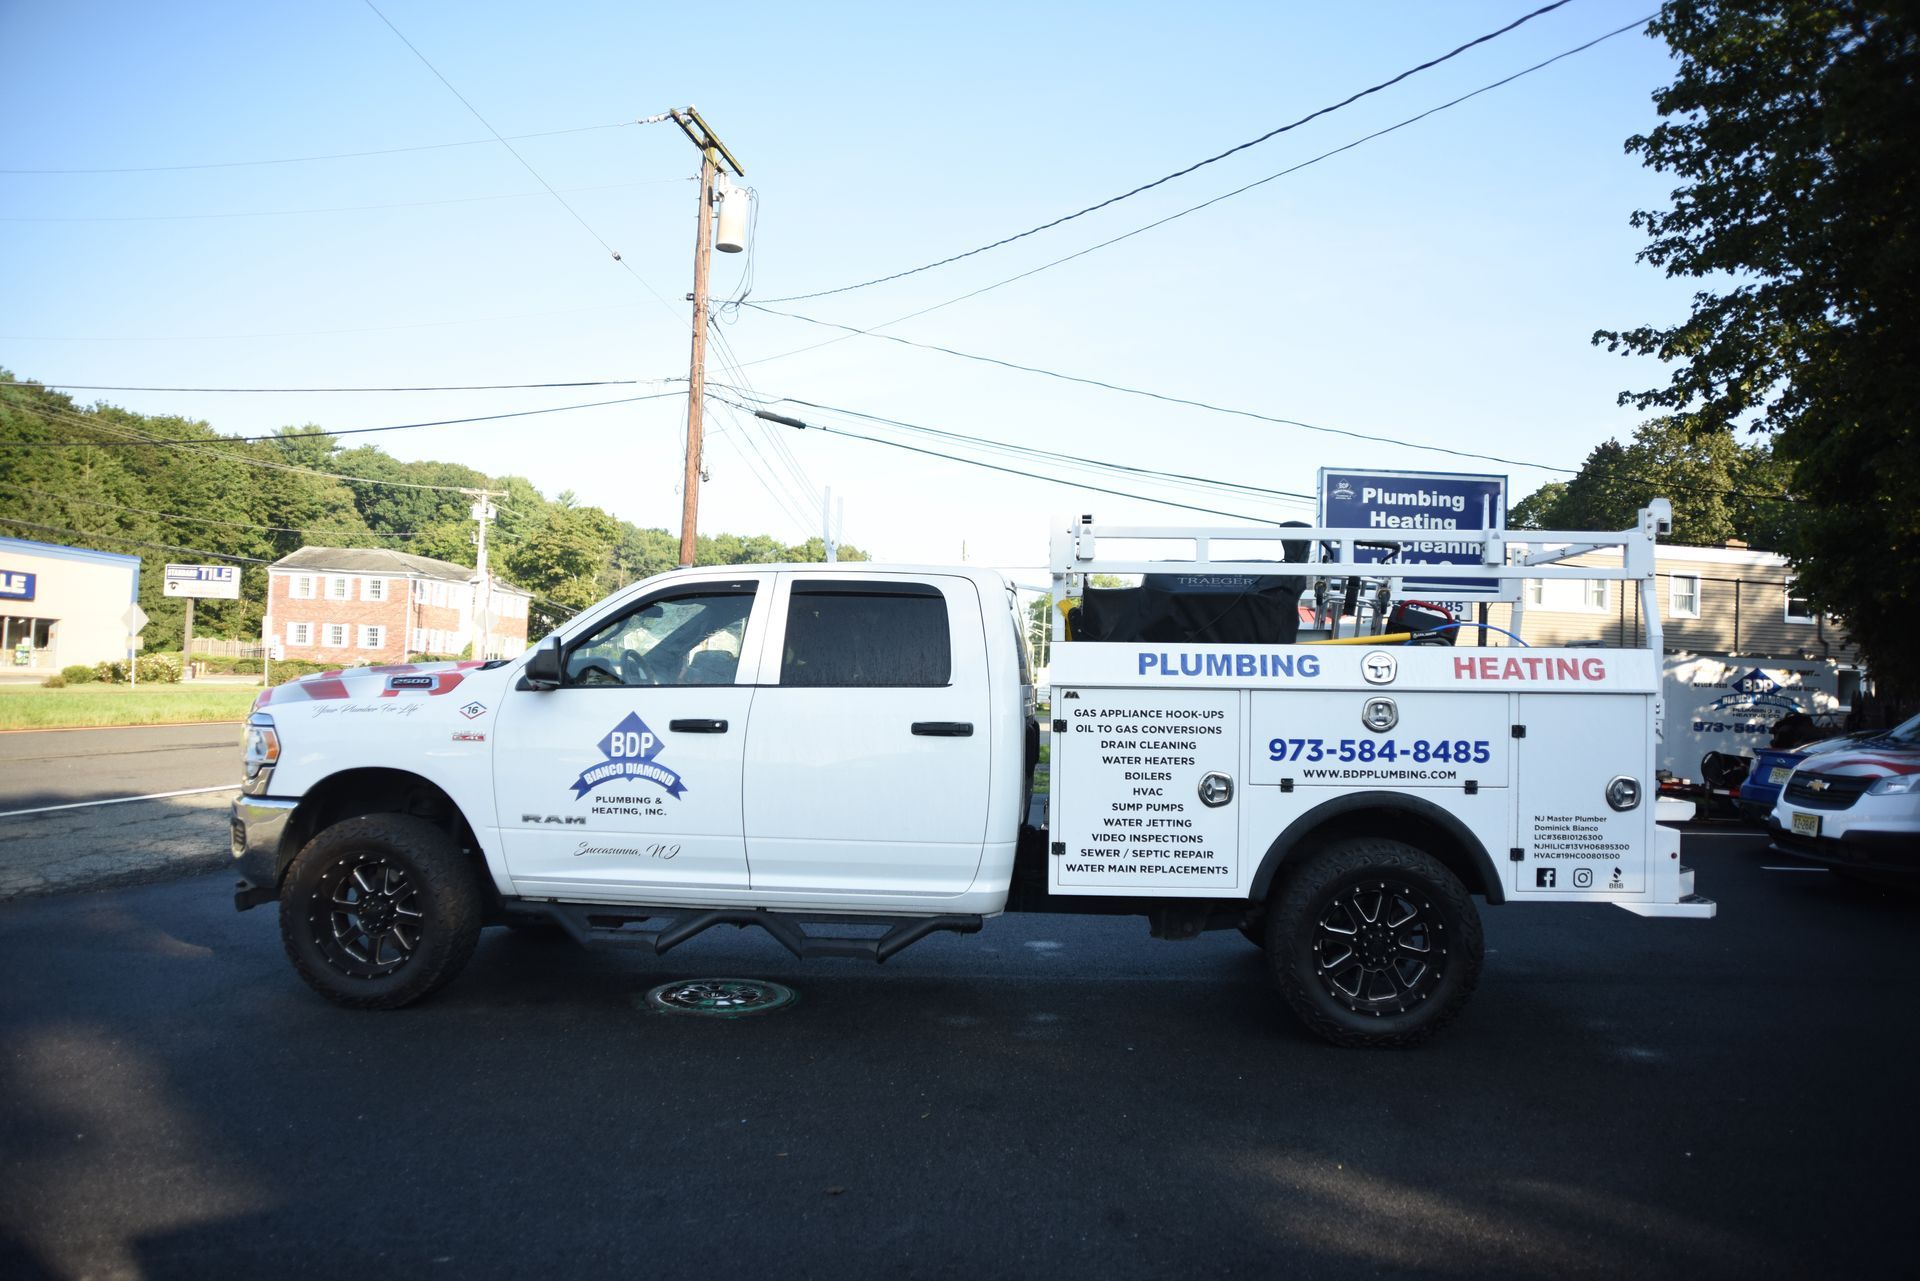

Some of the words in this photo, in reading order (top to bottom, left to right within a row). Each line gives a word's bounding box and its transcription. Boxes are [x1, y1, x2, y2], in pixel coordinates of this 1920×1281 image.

[1362, 487, 1465, 511] Plumbing
[1370, 511, 1456, 530] Heating
[199, 567, 232, 581] TILE
[1177, 577, 1254, 585] TRAEGER
[1138, 652, 1321, 678] PLUMBING
[1454, 656, 1606, 681] HEATING
[1743, 679, 1774, 692] BDP
[1722, 695, 1752, 704] BIANCO
[467, 706, 479, 715] 16
[1074, 709, 1096, 718] GAS
[1100, 710, 1162, 718] APPLIANCE
[1165, 710, 1224, 719] HOOK-UPS
[1076, 725, 1094, 733] OIL
[1097, 725, 1112, 733] TO
[1115, 725, 1138, 733] GAS
[1142, 726, 1222, 735] CONVERSIONS
[610, 732, 654, 758] BDP
[1101, 741, 1136, 749] DRAIN
[1140, 741, 1196, 750] CLEANING
[1269, 738, 1490, 763] 973-584-8485
[1102, 756, 1141, 765] WATER
[1144, 757, 1195, 765] HEATERS
[583, 763, 624, 785] BIANCO
[625, 763, 675, 787] DIAMOND
[1125, 772, 1172, 780] BOILERS
[1303, 770, 1456, 779] WWW.BDPPLUMBING.COM
[1133, 788, 1163, 796] HVAC
[596, 796, 651, 804] PLUMBING
[592, 807, 642, 816] HEATING,
[646, 808, 667, 816] INC.
[1112, 803, 1143, 811] SUMP
[1146, 803, 1184, 812] PUMPS
[522, 814, 586, 824] RAM
[1103, 819, 1143, 827] WATER
[1146, 819, 1192, 828] JETTING
[1092, 834, 1126, 842] VIDEO
[1129, 834, 1203, 843] INSPECTIONS
[574, 841, 641, 857] Succasunna,
[646, 844, 681, 859] NJ
[1080, 849, 1120, 858] SEWER
[1123, 849, 1129, 859] /
[1132, 850, 1170, 858] SEPTIC
[1174, 850, 1214, 859] REPAIR
[1066, 864, 1104, 873] WATER
[1108, 864, 1136, 873] MAIN
[1140, 865, 1228, 874] REPLACEMENTS
